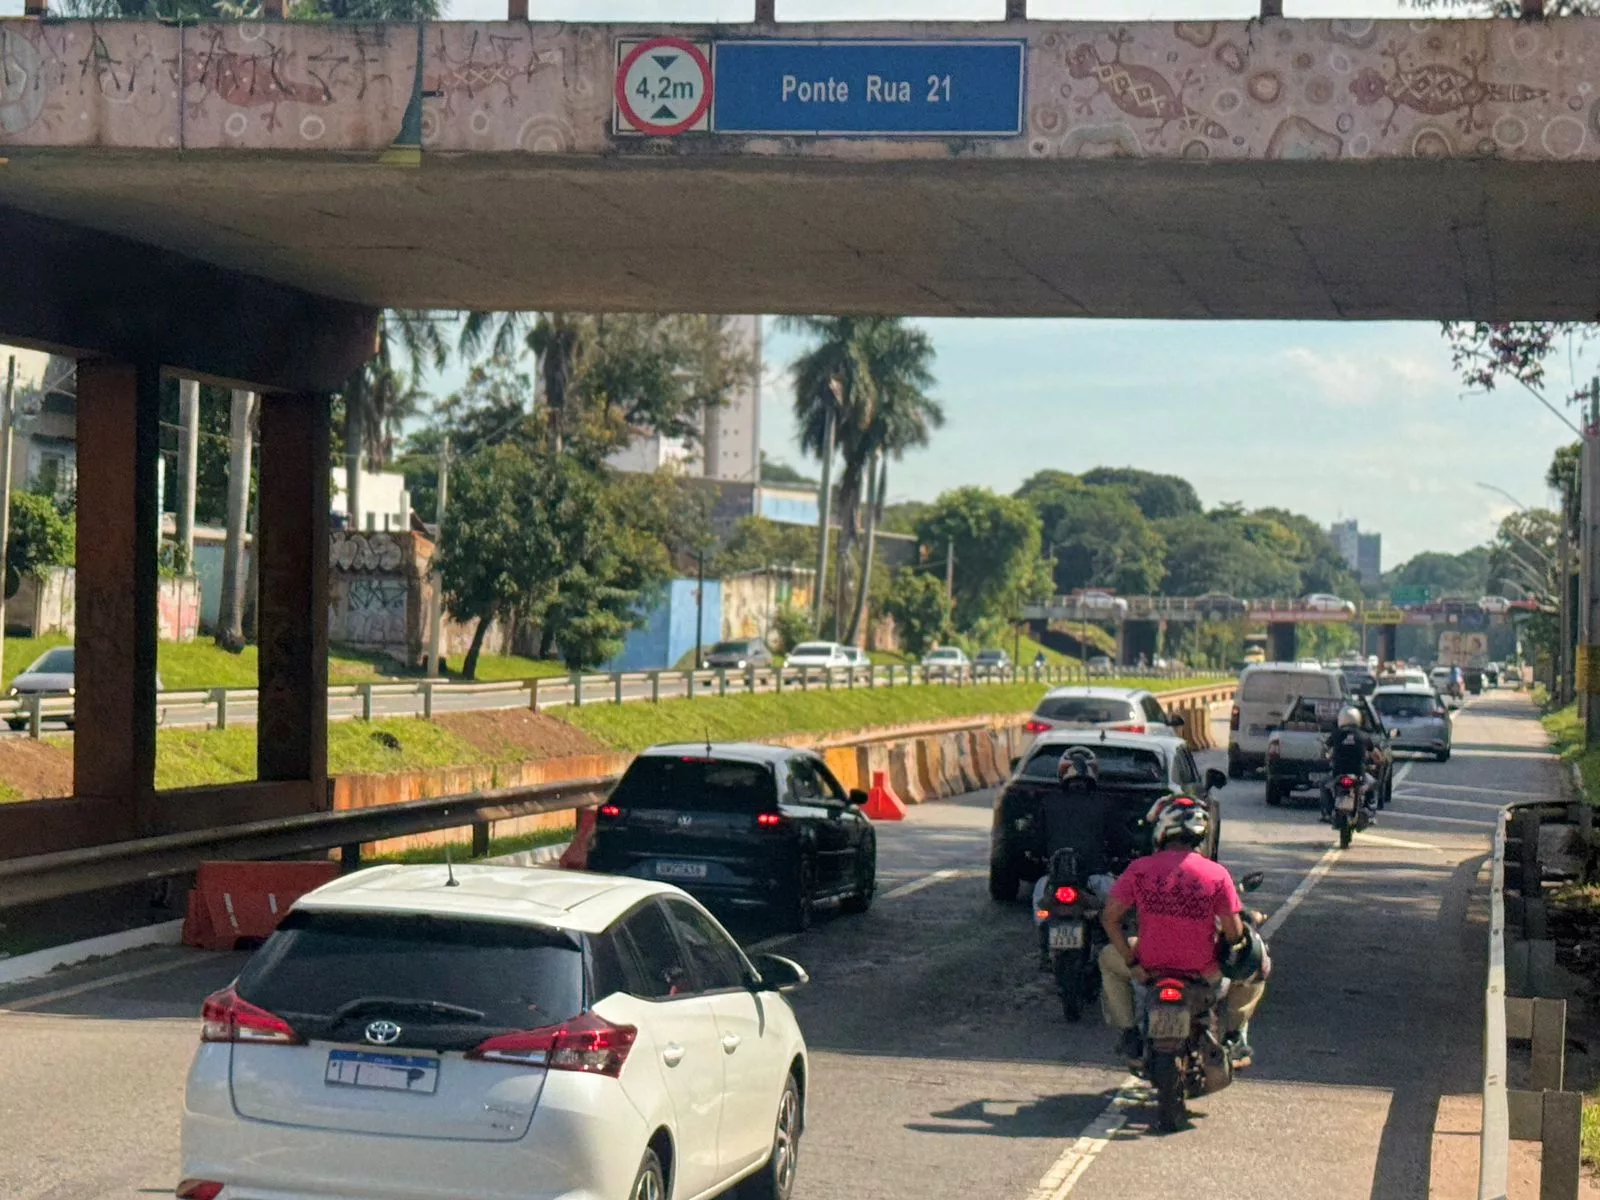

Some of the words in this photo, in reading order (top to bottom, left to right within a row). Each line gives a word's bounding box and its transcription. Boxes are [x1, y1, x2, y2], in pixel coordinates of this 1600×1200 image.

[636, 76, 694, 103] 4,2m
[782, 75, 849, 102] Ponte
[866, 74, 911, 102] Rua
[927, 74, 951, 102] 21
